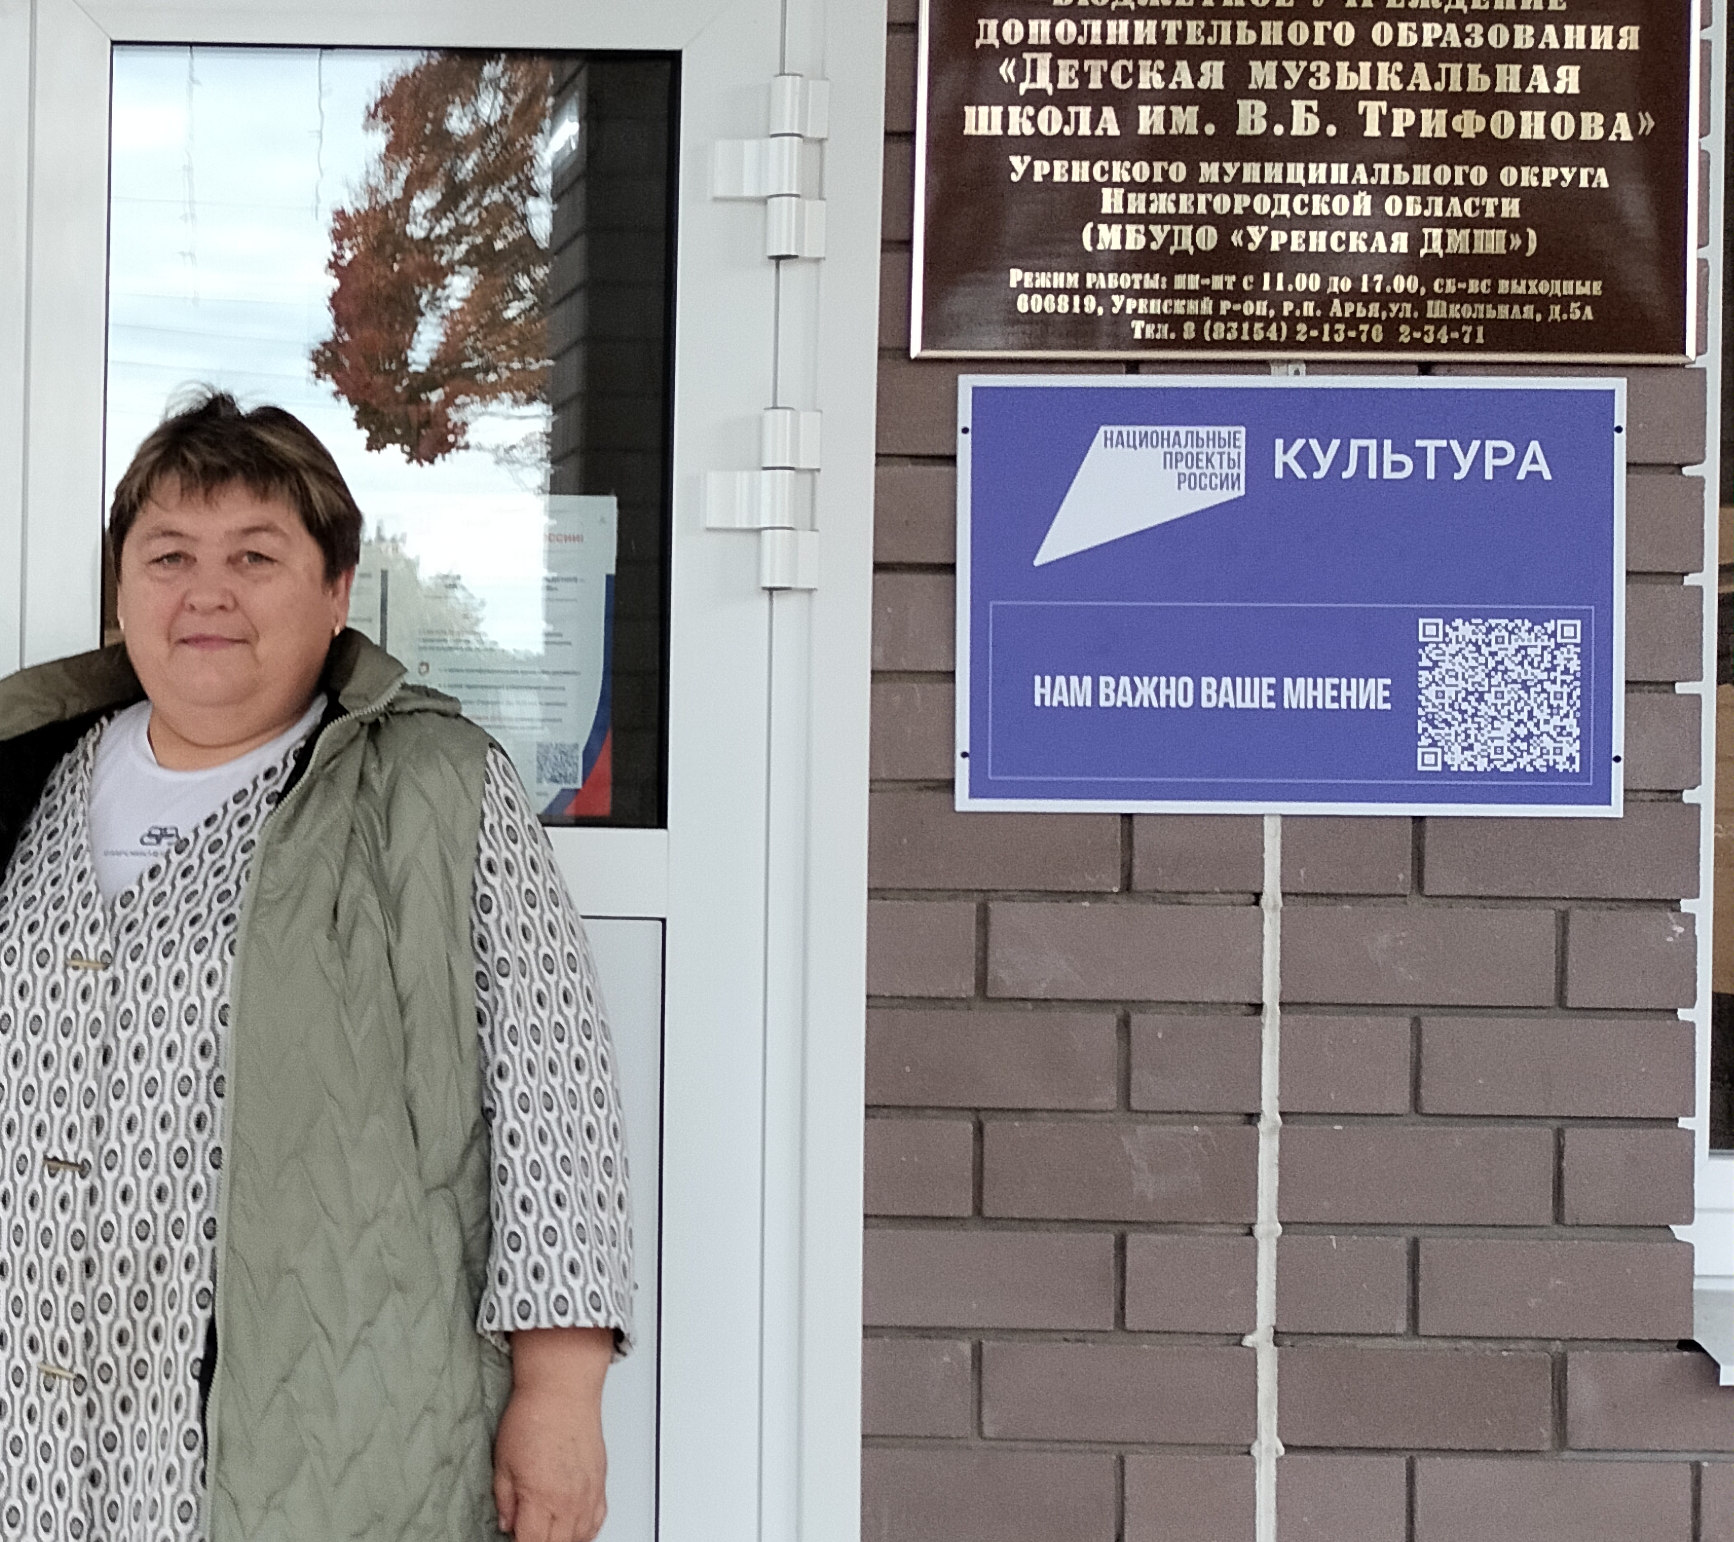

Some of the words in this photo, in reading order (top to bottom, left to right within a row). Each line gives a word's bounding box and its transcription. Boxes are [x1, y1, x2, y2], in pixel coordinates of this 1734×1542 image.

[1102, 429, 1242, 451] НАЦИОНАЛЬНЫЕ
[1162, 451, 1242, 472] ПРОЕКТЫ
[1274, 437, 1552, 480] КУЛЬТУРА
[1176, 471, 1242, 492] РОССИИ
[1033, 674, 1092, 707] НАМ
[1099, 675, 1194, 708] ВАЖНО
[1200, 676, 1276, 709] ВАШЕ
[1283, 676, 1392, 710] МНЕНИЕ
